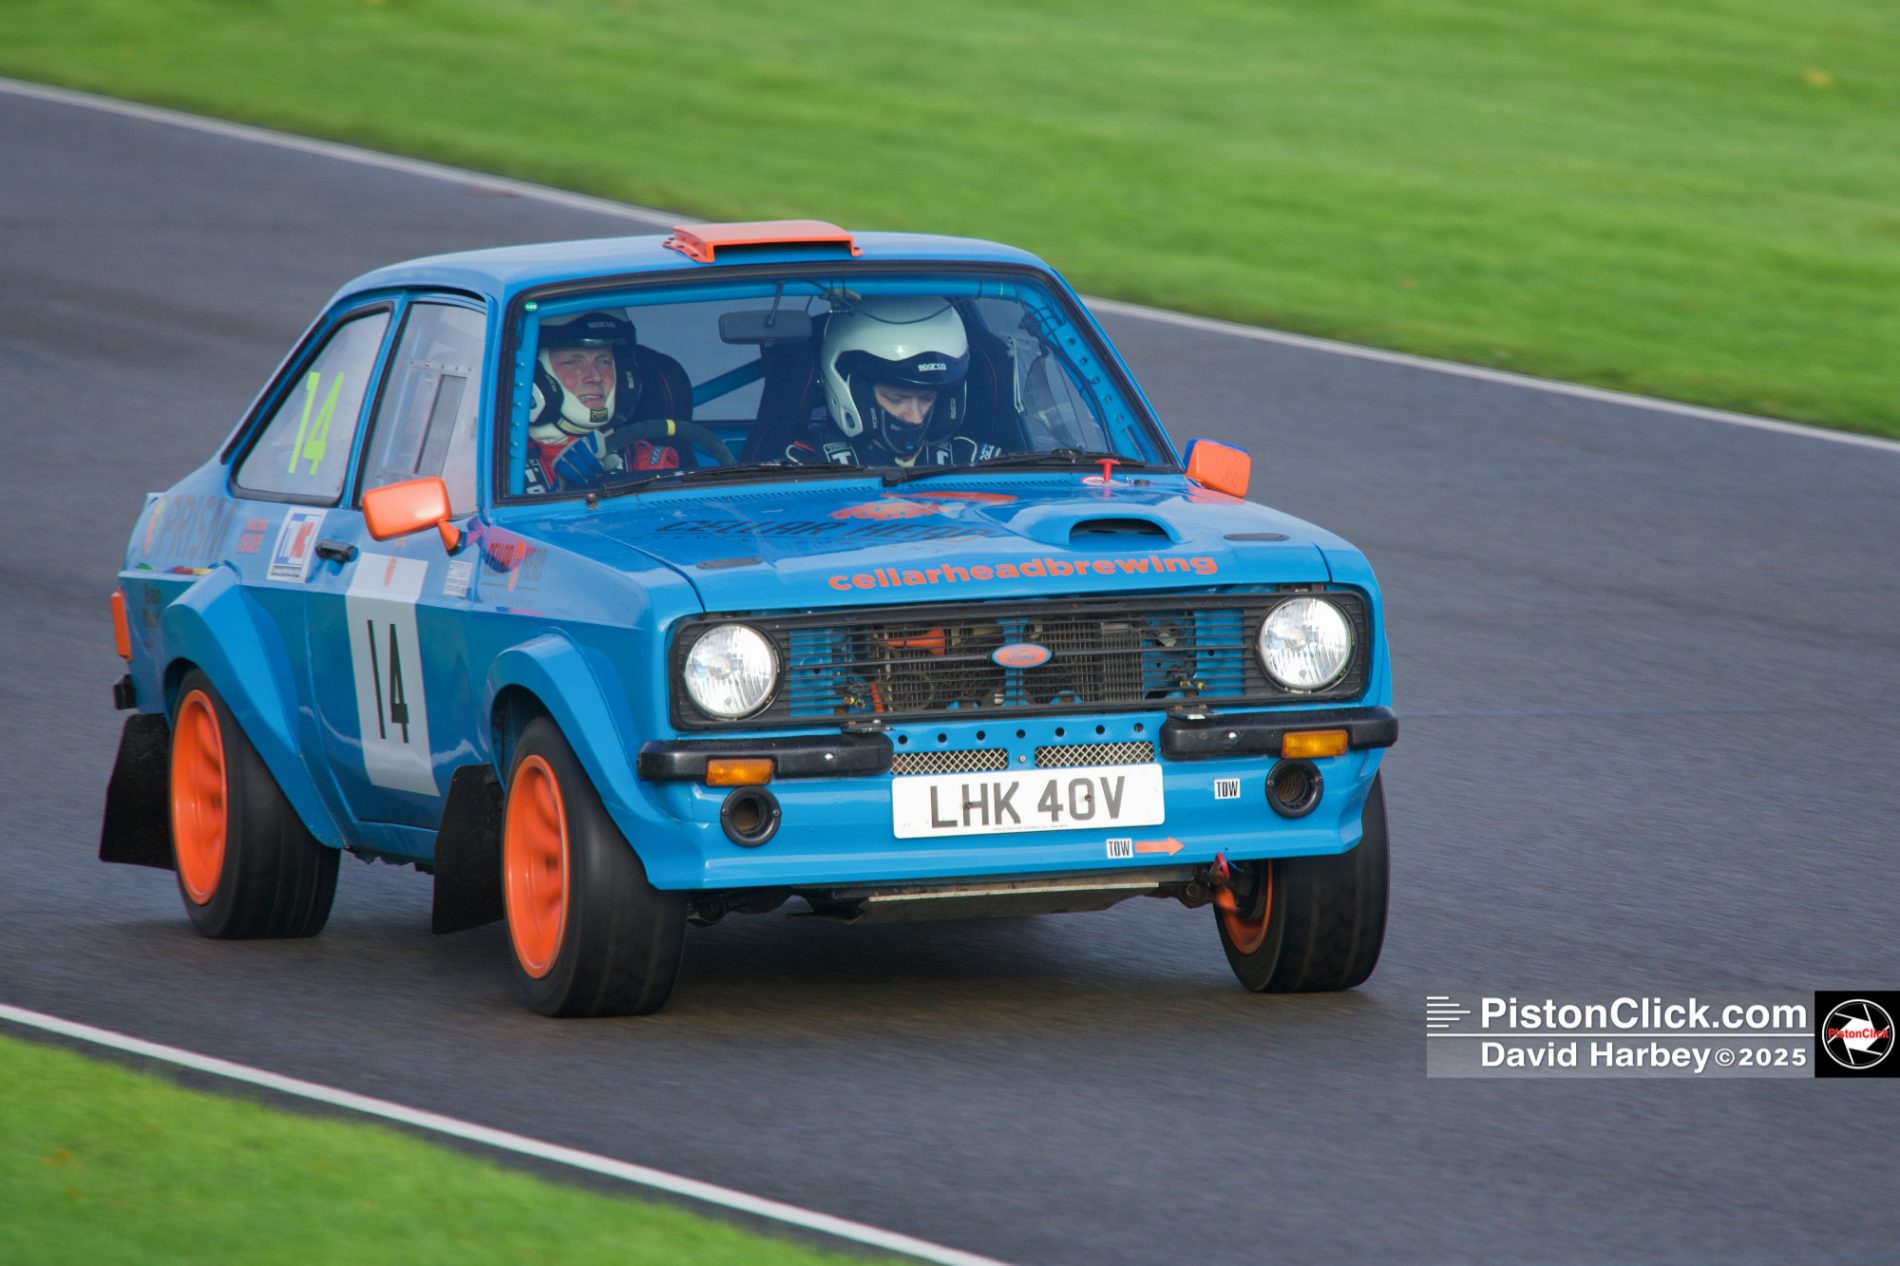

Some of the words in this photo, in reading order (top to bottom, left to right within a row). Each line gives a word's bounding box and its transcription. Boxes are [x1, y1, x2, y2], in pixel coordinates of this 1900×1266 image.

[287, 371, 344, 476] 14
[155, 494, 241, 561] PRISM
[655, 519, 848, 536] CELLAR
[828, 554, 1218, 591] cellarheadbrewing
[367, 619, 410, 744] 14
[930, 780, 1021, 829] LHK
[1037, 775, 1126, 823] 40V
[1216, 781, 1239, 798] TOW
[1108, 840, 1131, 857] TOW
